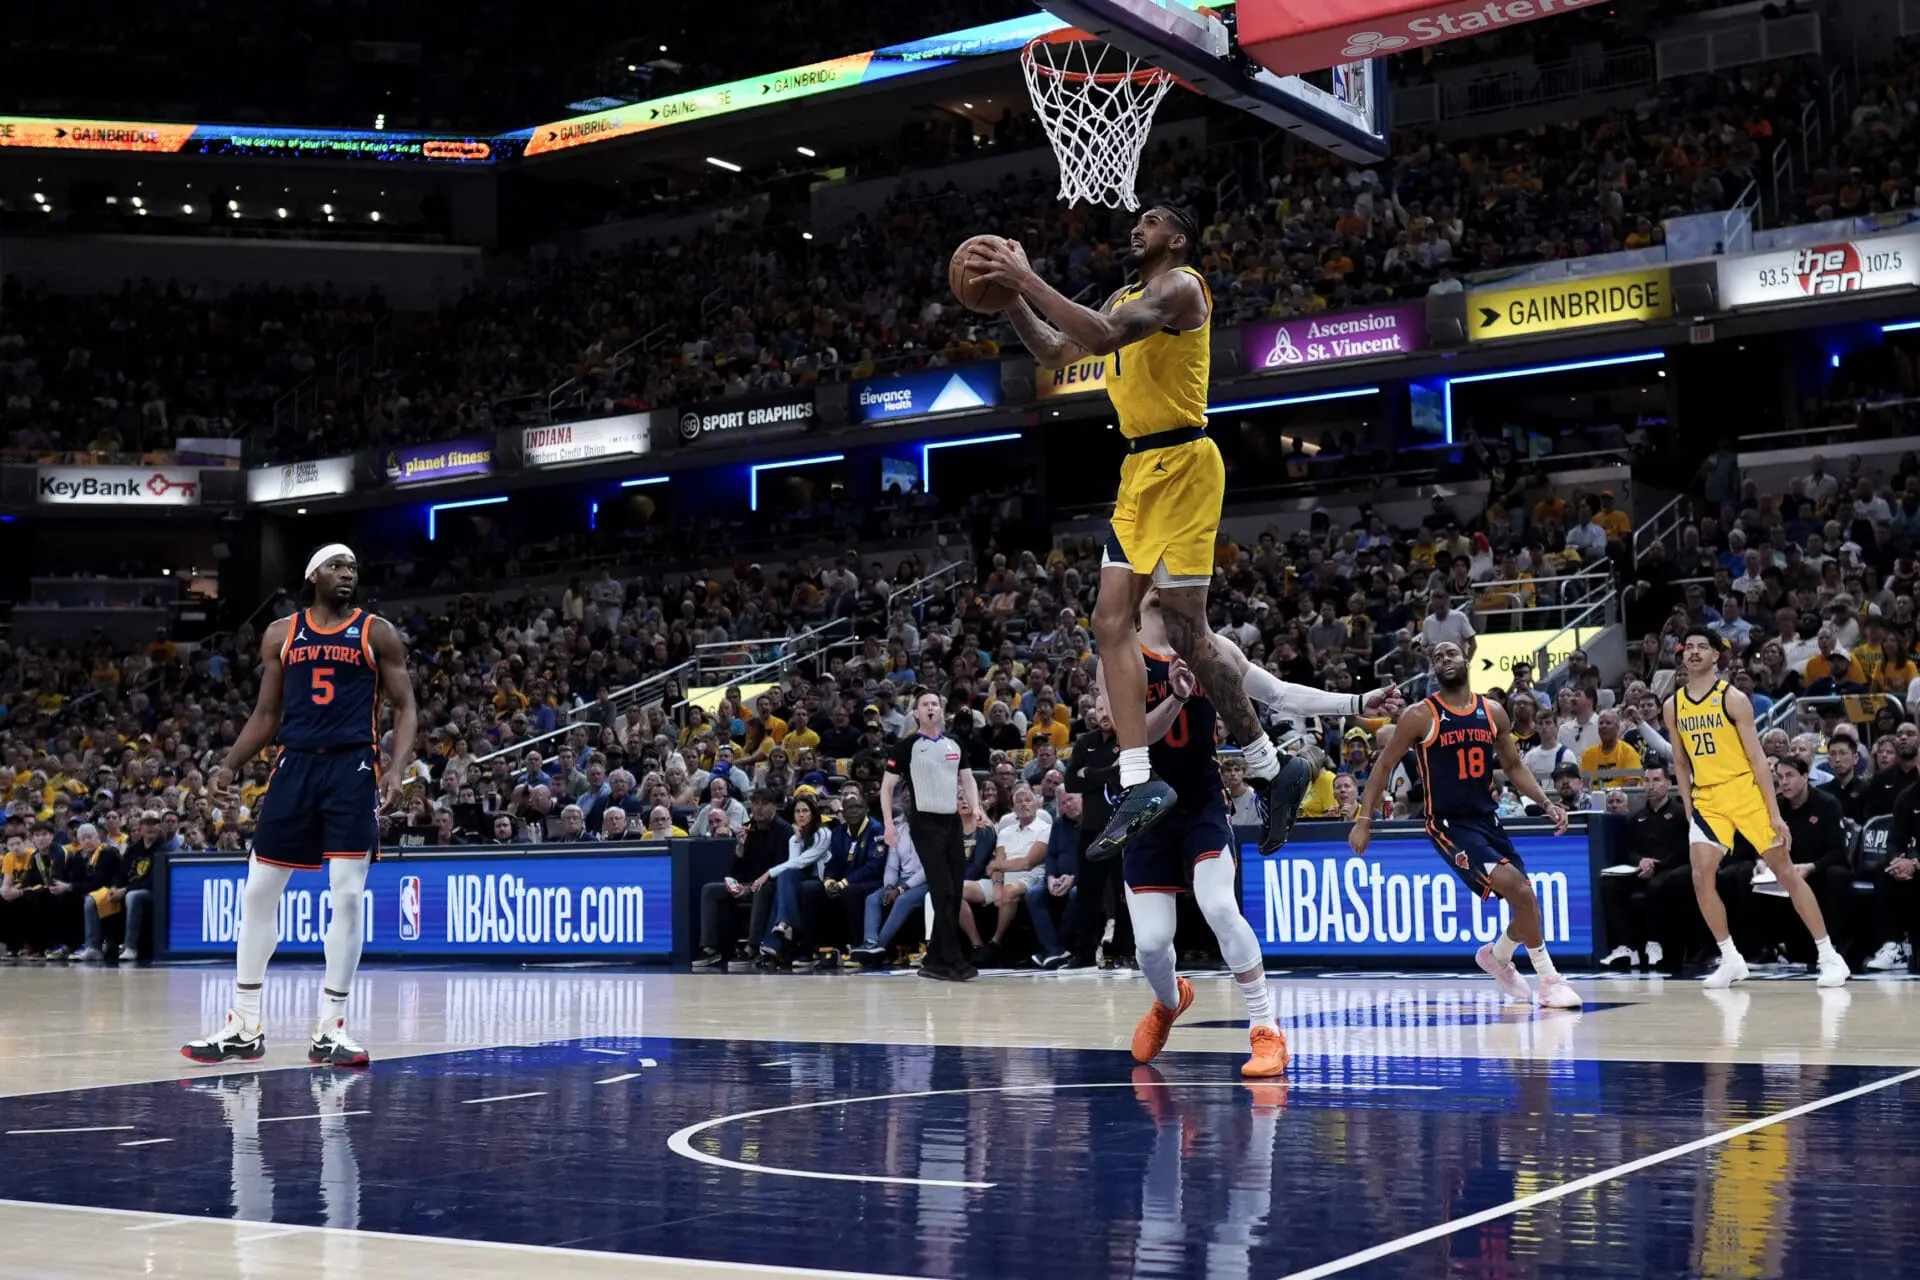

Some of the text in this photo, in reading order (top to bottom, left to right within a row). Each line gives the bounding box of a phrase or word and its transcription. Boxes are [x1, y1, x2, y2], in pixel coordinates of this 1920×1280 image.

[774, 68, 837, 93] GAINBRIDG
[1759, 248, 1902, 288] 93.5 the 107.5
[1808, 270, 1863, 296] fan
[1508, 280, 1660, 326] GAINBRIDGE
[1307, 313, 1396, 339] Ascension
[1307, 333, 1401, 361] St. Vincent
[860, 387, 912, 405] Elevance
[702, 412, 744, 431] SPORT
[748, 402, 813, 425] GRAPHICS
[526, 426, 572, 449] INDIANA
[405, 450, 490, 477] planet fitness
[39, 477, 141, 498] KeyBank
[289, 645, 361, 666] NEW YORK
[1500, 651, 1572, 672] GAINRI
[312, 668, 335, 705] 5
[1678, 713, 1723, 732] INDIANA
[1440, 728, 1493, 747] NEW YORK
[1691, 732, 1716, 756] 26
[1457, 747, 1485, 779] 18
[202, 873, 644, 943] NBAore.c NBAStore.com
[1264, 858, 1569, 942] NBAStore.cm
